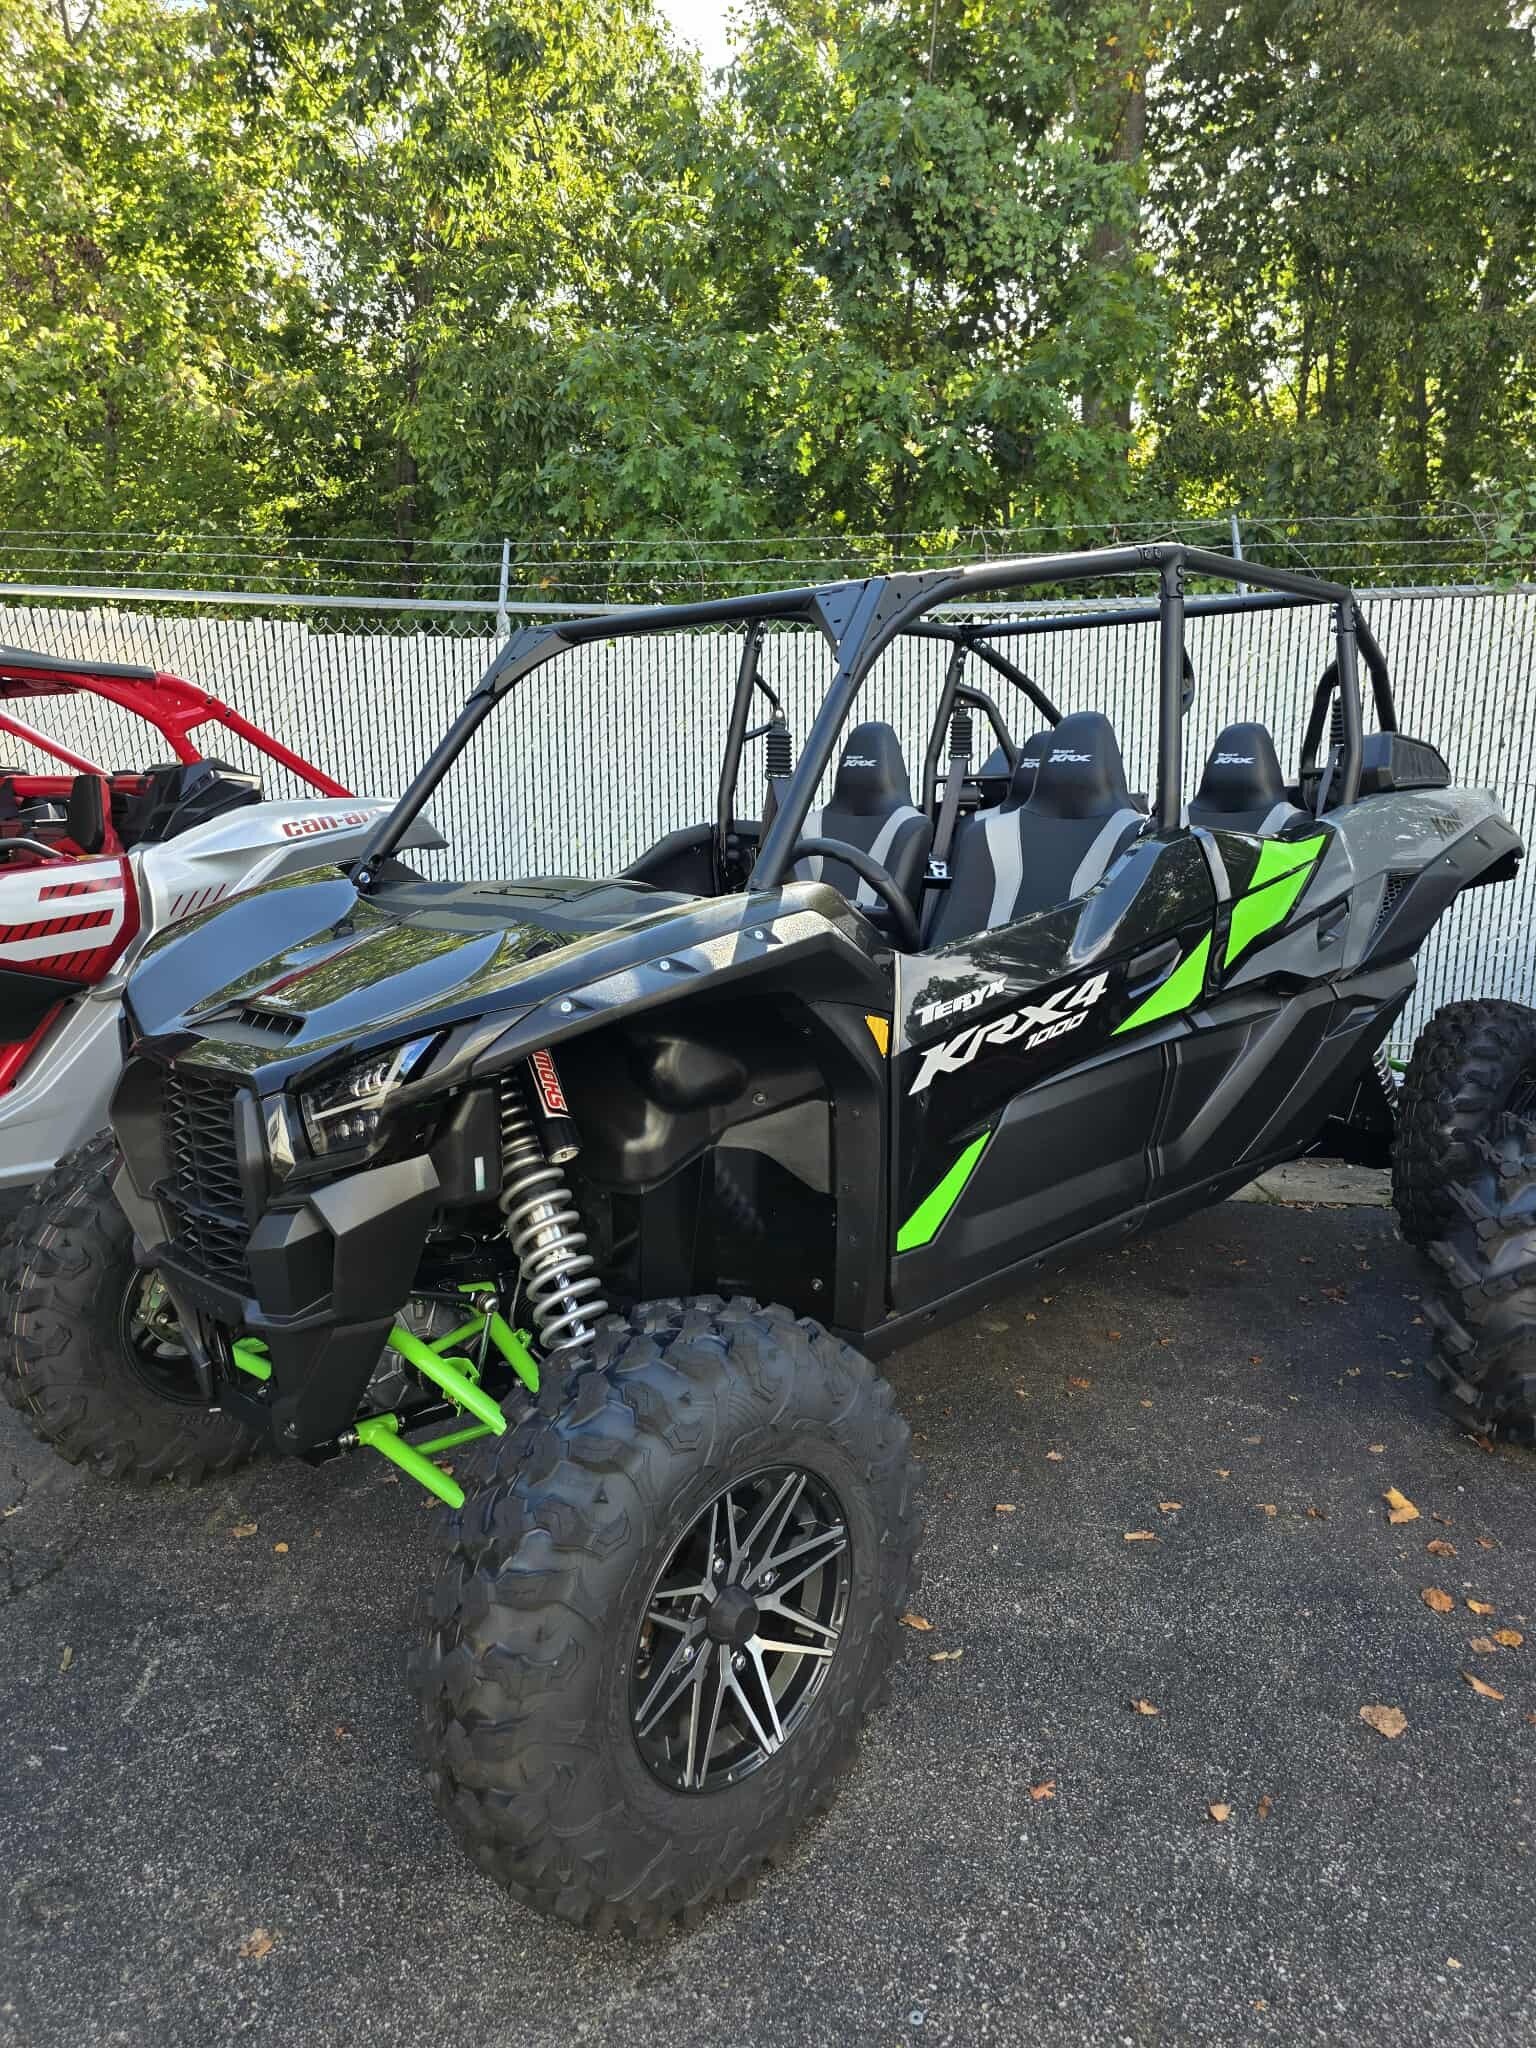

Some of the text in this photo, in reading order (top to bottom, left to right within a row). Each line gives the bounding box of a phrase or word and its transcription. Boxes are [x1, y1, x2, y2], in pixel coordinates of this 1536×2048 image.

[914, 974, 1008, 1026] TERYX
[1024, 1010, 1090, 1050] 1000
[532, 1049, 568, 1112] SHOW
